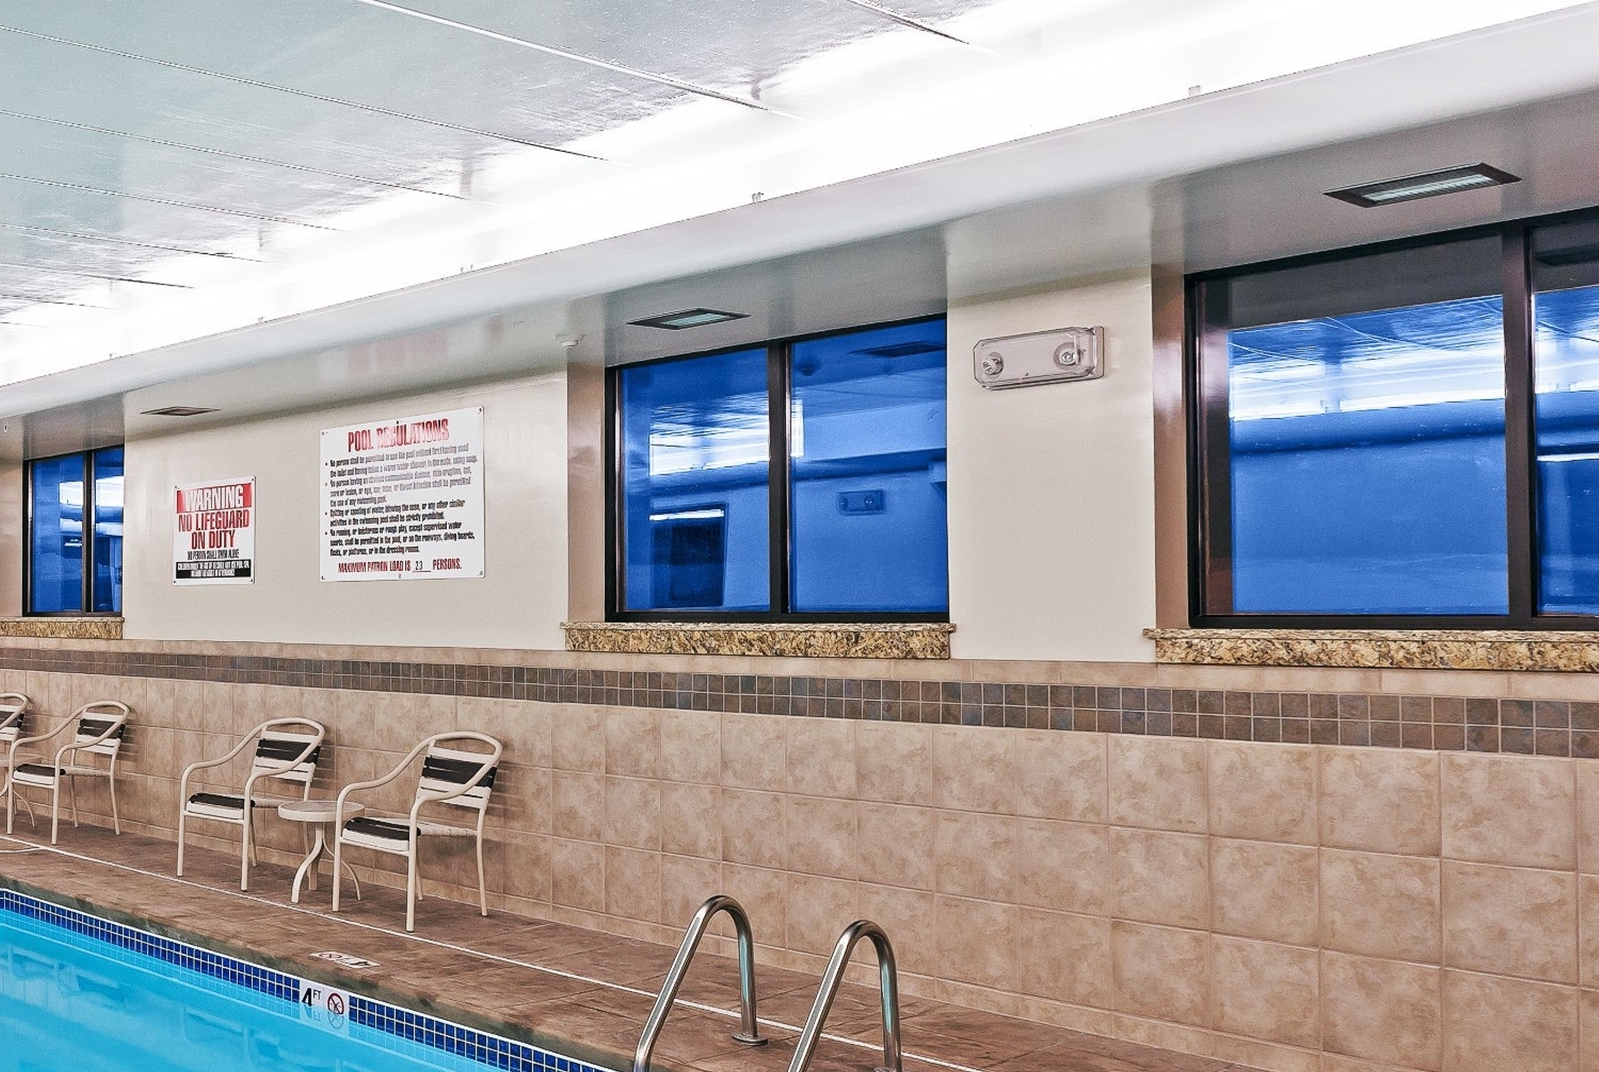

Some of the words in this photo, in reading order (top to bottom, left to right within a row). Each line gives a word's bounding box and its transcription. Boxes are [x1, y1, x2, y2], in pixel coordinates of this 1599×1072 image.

[347, 429, 373, 452] POOL
[184, 484, 244, 511] WARNING
[178, 514, 192, 532] NO
[196, 509, 250, 531] LIFEGUARD
[191, 531, 205, 549] ON
[209, 529, 235, 549] DUTY
[390, 560, 403, 571] LOAD
[405, 560, 411, 571] IS
[313, 989, 321, 999] FT
